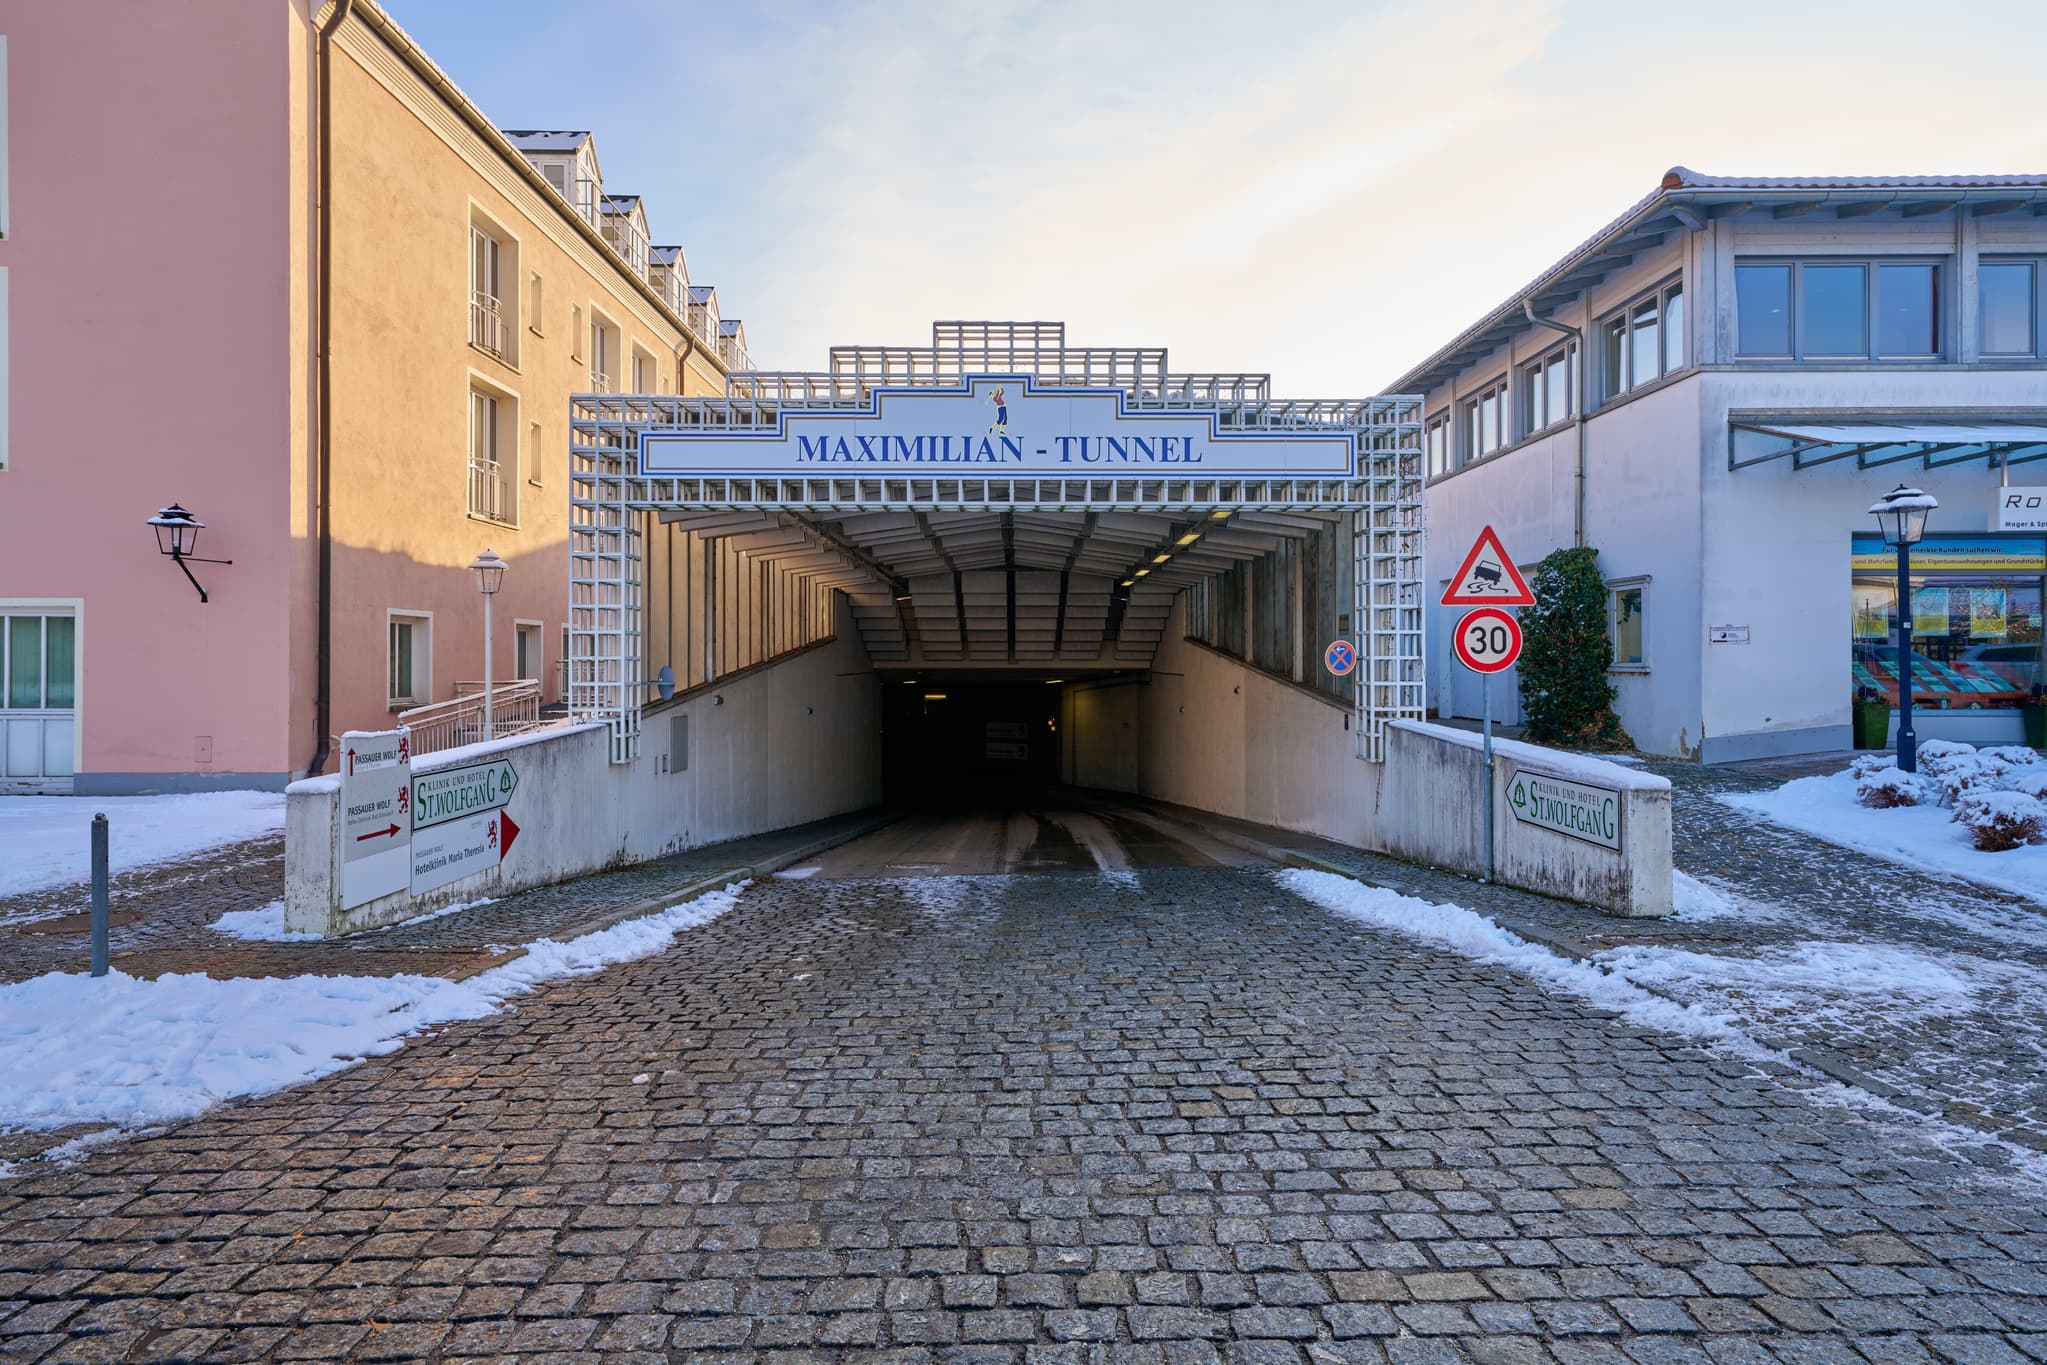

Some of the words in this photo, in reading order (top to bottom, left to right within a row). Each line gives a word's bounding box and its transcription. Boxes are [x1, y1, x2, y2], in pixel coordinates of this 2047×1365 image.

[797, 435, 1023, 463] MAXIMILIAN
[1054, 435, 1203, 463] TUNNEL
[1469, 626, 1507, 655] 30
[355, 752, 381, 765] PASSAUER
[383, 750, 397, 760] WOLF
[428, 779, 450, 791] KLINIK
[453, 776, 465, 786] UND
[467, 771, 485, 783] HOTEL
[1539, 782, 1560, 797] KLINIK
[1562, 789, 1576, 801] UND
[1578, 792, 1601, 807] HOTEL
[348, 802, 375, 816] PASSAUER
[376, 799, 391, 810] WOLF
[448, 850, 463, 864] Maria
[464, 843, 485, 858] Theresia
